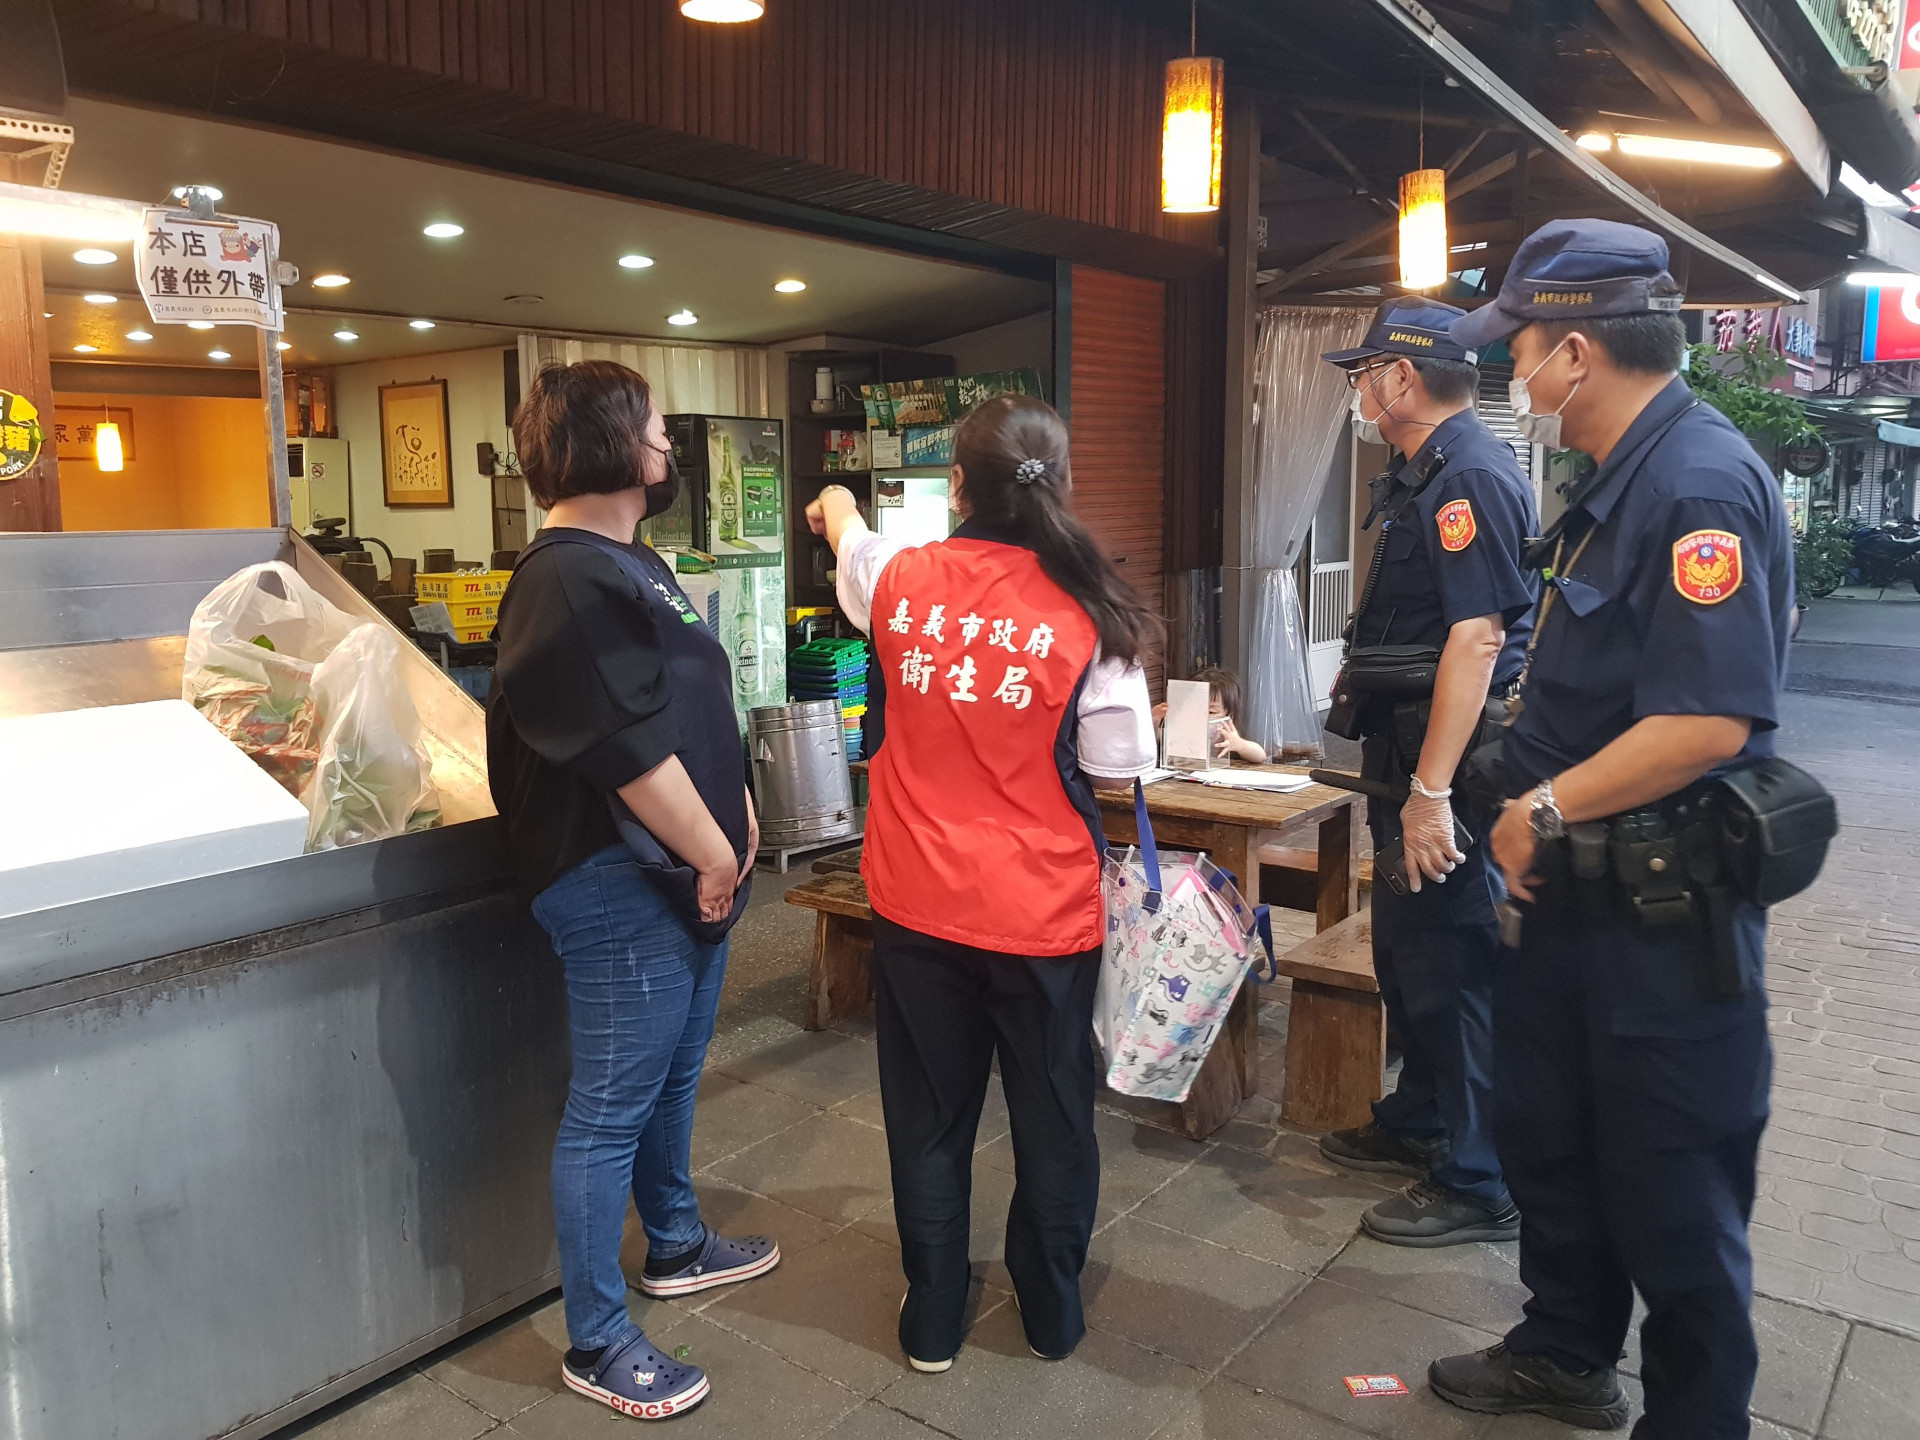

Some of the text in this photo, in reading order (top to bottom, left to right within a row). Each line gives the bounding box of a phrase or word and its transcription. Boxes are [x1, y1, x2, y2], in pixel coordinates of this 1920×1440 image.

[149, 227, 207, 257] 本店
[150, 265, 266, 299] 僅供外帶
[1, 460, 25, 476] PORK
[465, 583, 480, 592] TTL
[1699, 587, 1721, 597] 730
[466, 607, 482, 616] TTL
[467, 632, 484, 640] TTL
[887, 596, 1056, 660] 嘉義市政府
[898, 644, 1034, 710] 衛生局
[610, 1395, 674, 1417] crocs
